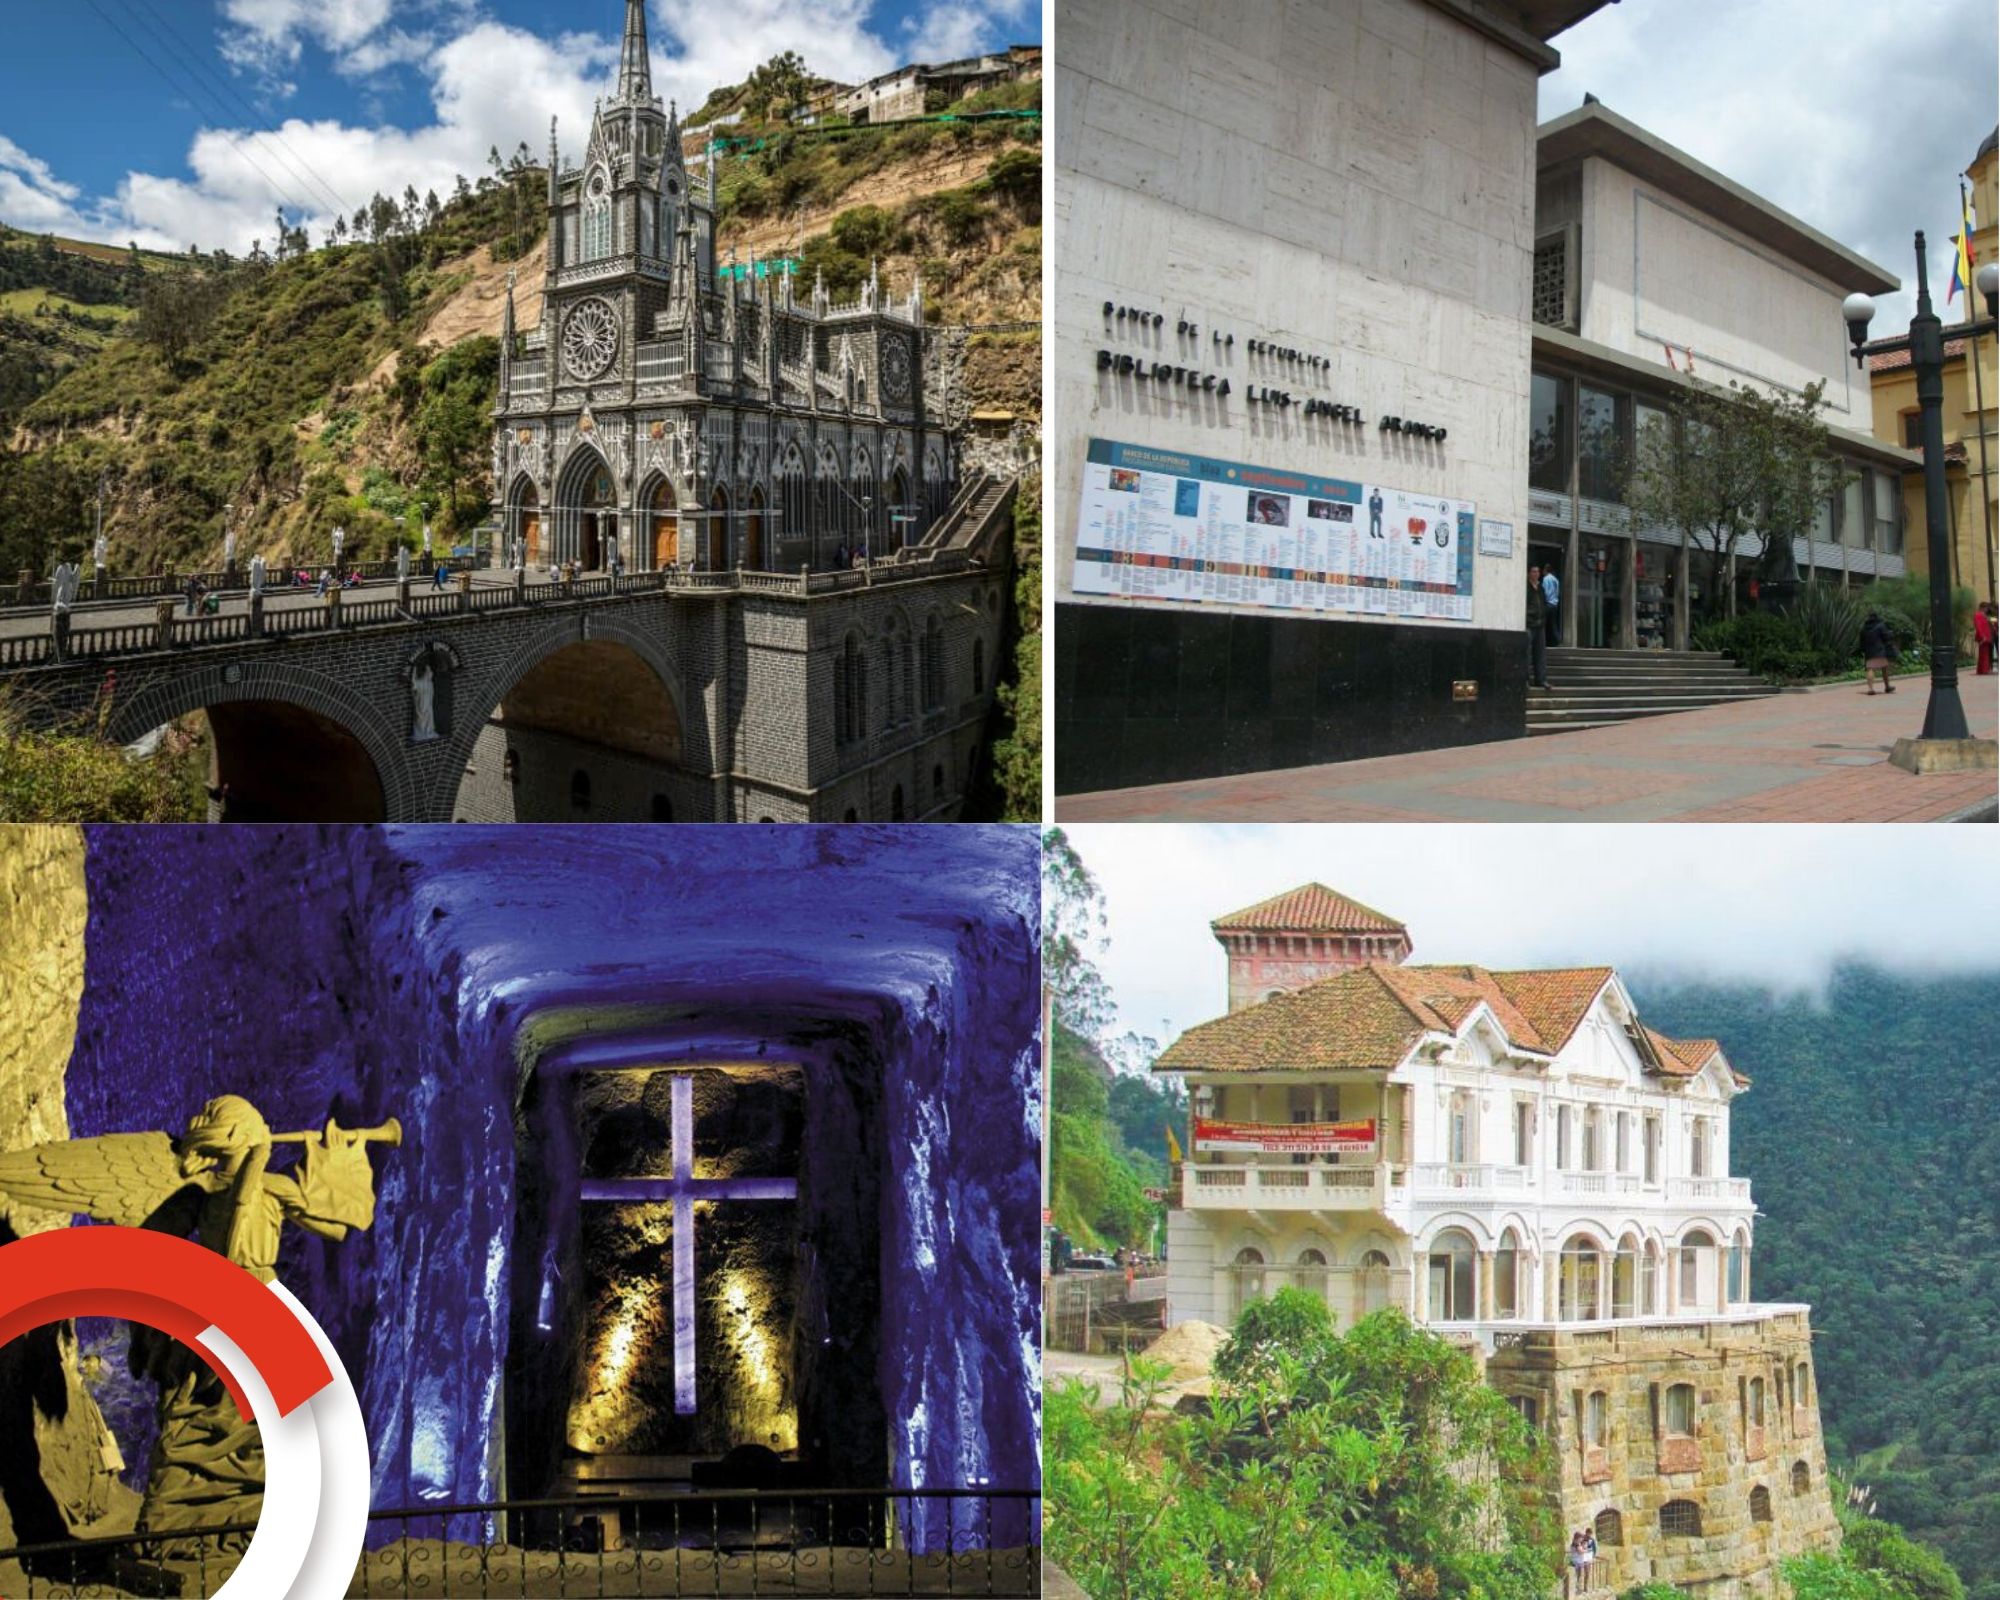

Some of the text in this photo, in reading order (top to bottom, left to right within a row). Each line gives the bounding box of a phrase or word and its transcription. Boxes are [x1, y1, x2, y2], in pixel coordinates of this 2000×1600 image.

[1103, 301, 1331, 370] BANCO DE LA REPUBLICA
[1097, 350, 1231, 395] BIBLIOTECA
[1379, 415, 1447, 442] ARANGO
[1205, 561, 1215, 573] 9
